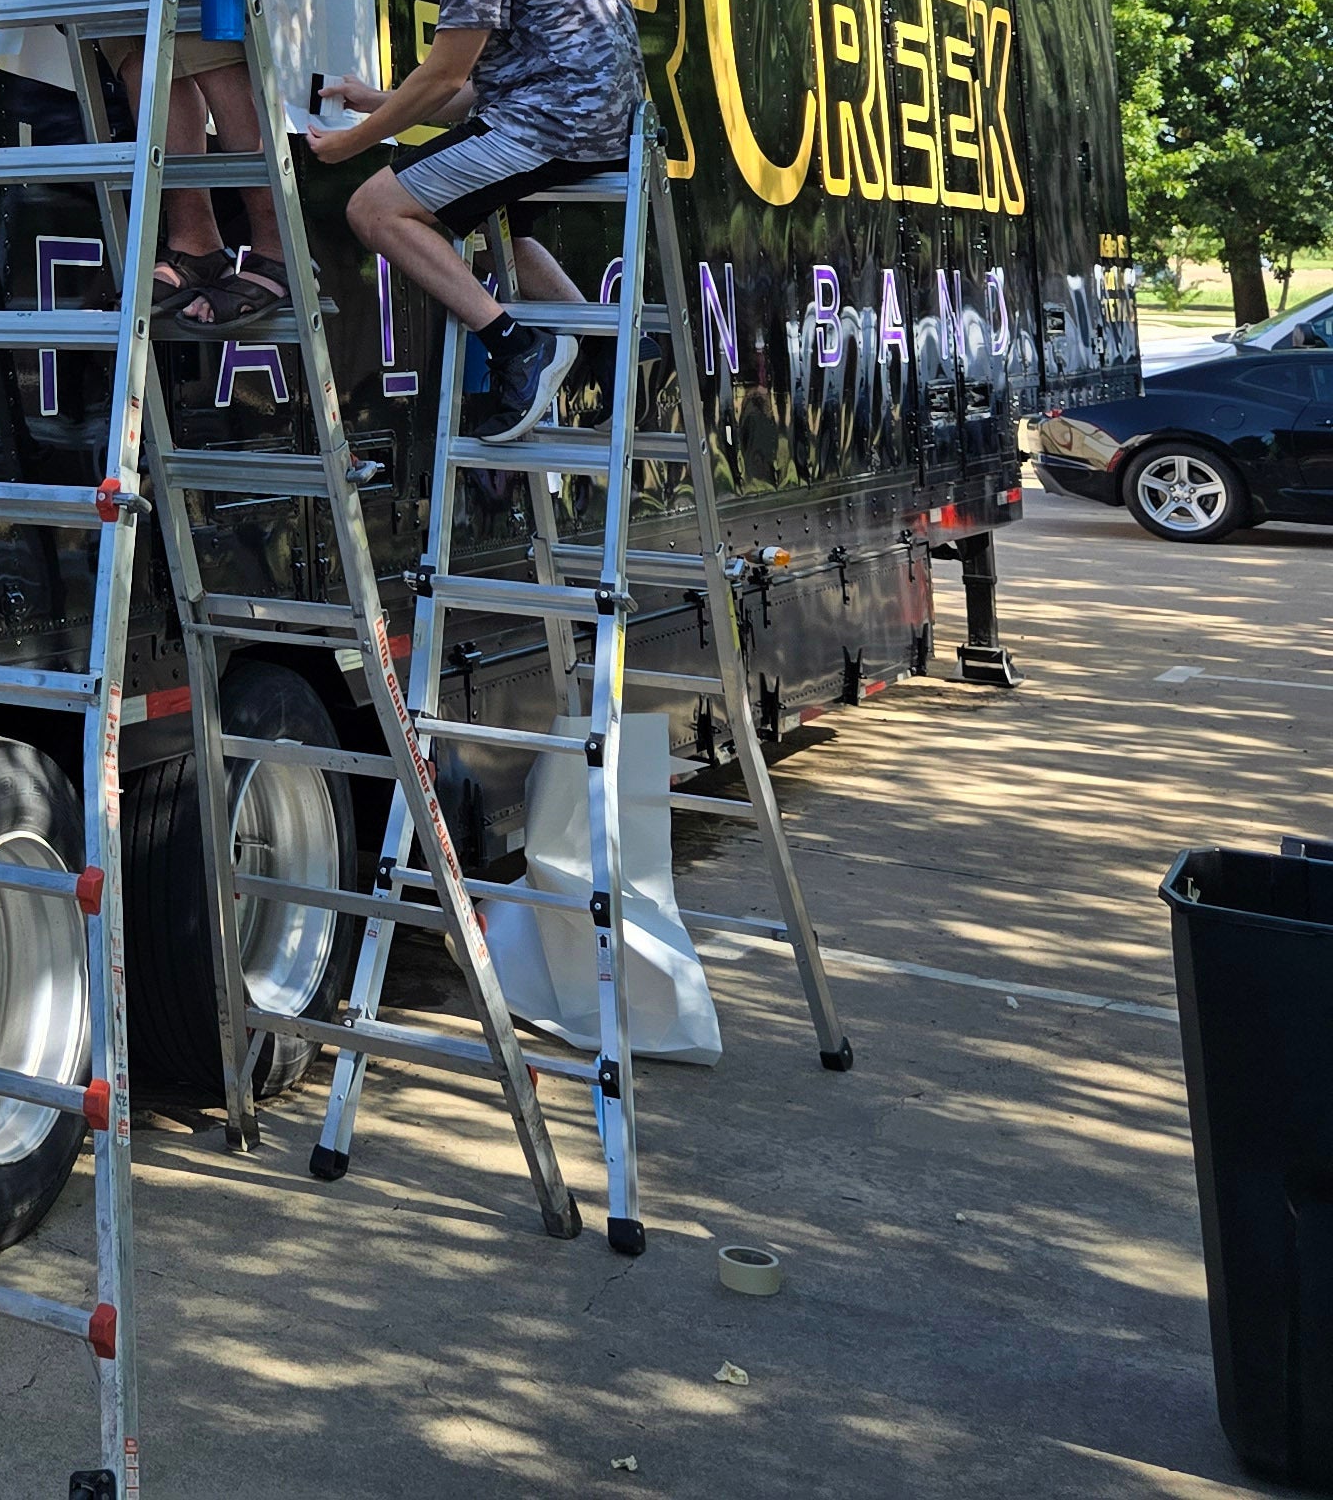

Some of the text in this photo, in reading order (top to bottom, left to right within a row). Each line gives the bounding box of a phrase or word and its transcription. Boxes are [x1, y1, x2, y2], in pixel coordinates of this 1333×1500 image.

[813, 264, 1010, 369] BAND
[373, 616, 390, 670] Little
[386, 671, 409, 725] Giant
[404, 725, 432, 794] Ladder
